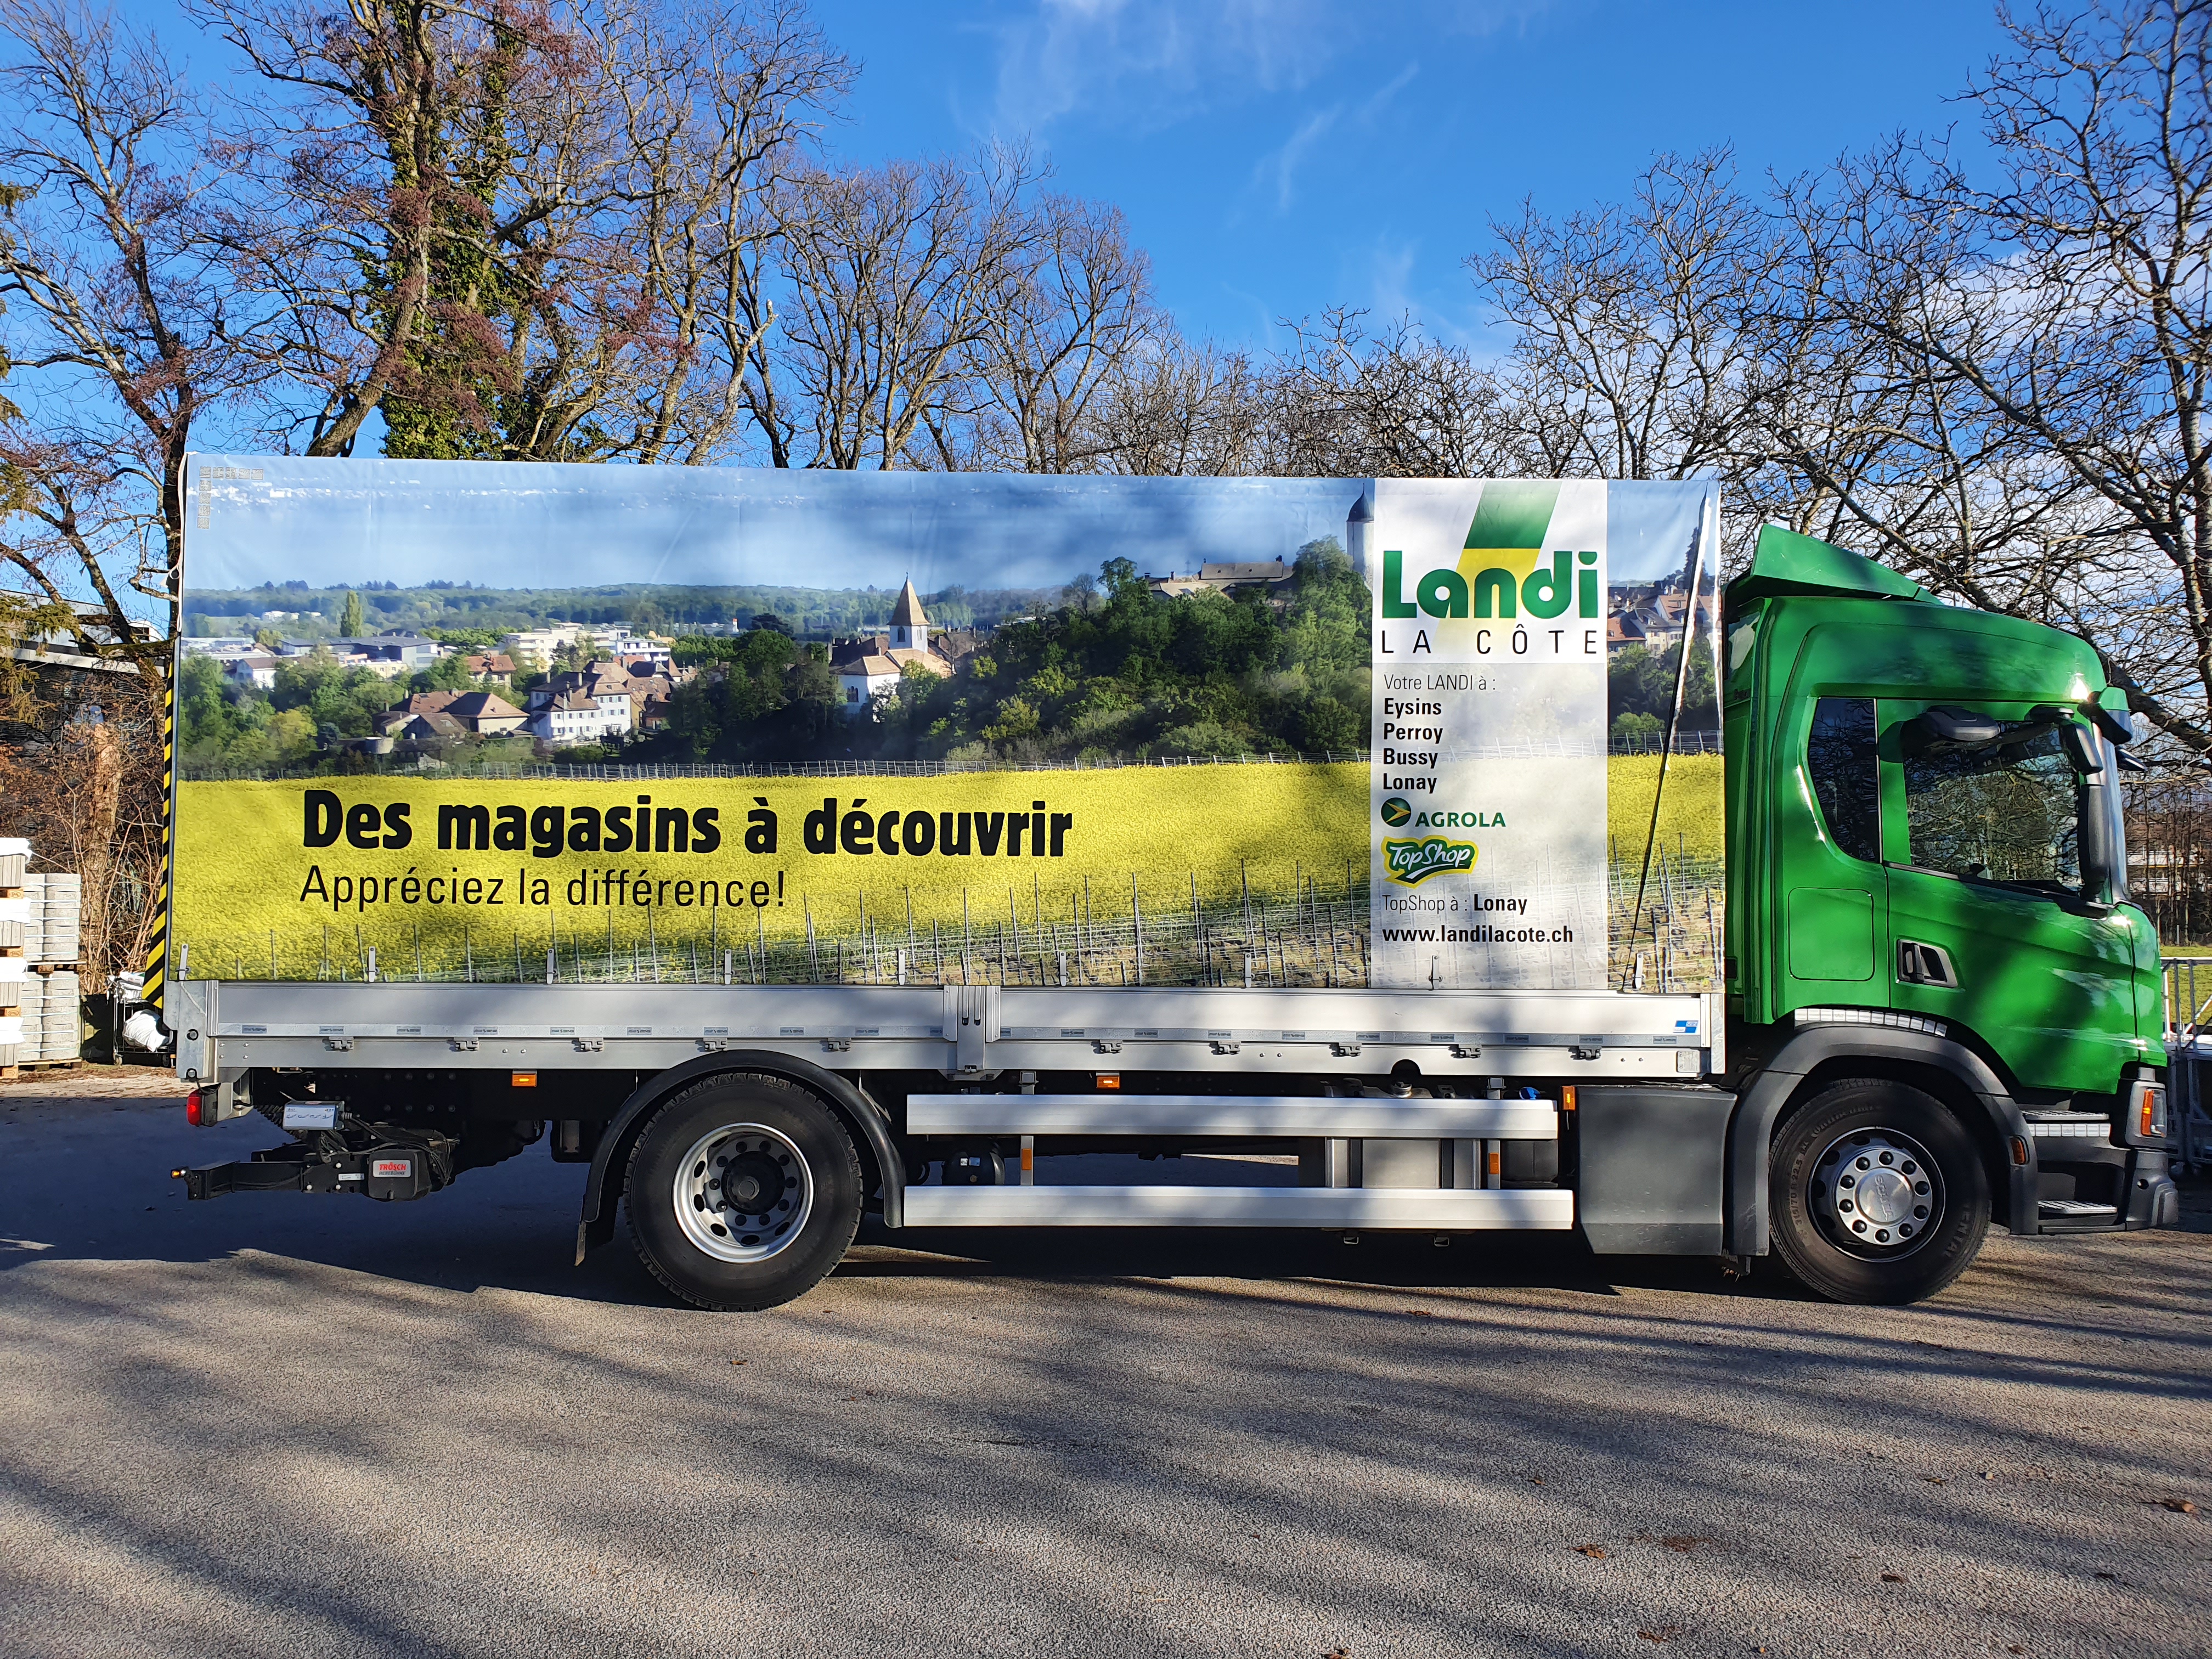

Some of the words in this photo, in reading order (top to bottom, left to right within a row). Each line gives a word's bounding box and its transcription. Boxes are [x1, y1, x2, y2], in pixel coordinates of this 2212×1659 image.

[1383, 550, 1599, 619] Landi
[1382, 629, 1431, 654] LA
[1477, 624, 1598, 654] CÔTE
[1383, 674, 1422, 690] Votre
[1427, 674, 1473, 690] LANDI
[1479, 675, 1487, 690] à
[1492, 679, 1496, 690] :
[1384, 697, 1442, 719] Eysins
[1383, 723, 1444, 744] Perroy
[1383, 748, 1439, 770] Bussy
[1383, 772, 1438, 794] Lonay
[303, 789, 413, 850] Des
[437, 795, 721, 859] magasins
[744, 797, 778, 854] à
[803, 798, 1073, 857] découvrir
[1414, 811, 1506, 828] AGROLA
[1389, 843, 1471, 871] TopShop
[300, 865, 504, 912] Appréciez
[519, 868, 550, 905] la
[567, 868, 785, 907] différence!
[1381, 894, 1445, 915] TopShop
[1449, 896, 1459, 911] à
[1473, 894, 1528, 916] Lonay
[1381, 924, 1573, 943] www.landilacote.ch
[379, 1162, 407, 1170] TRÖSCH
